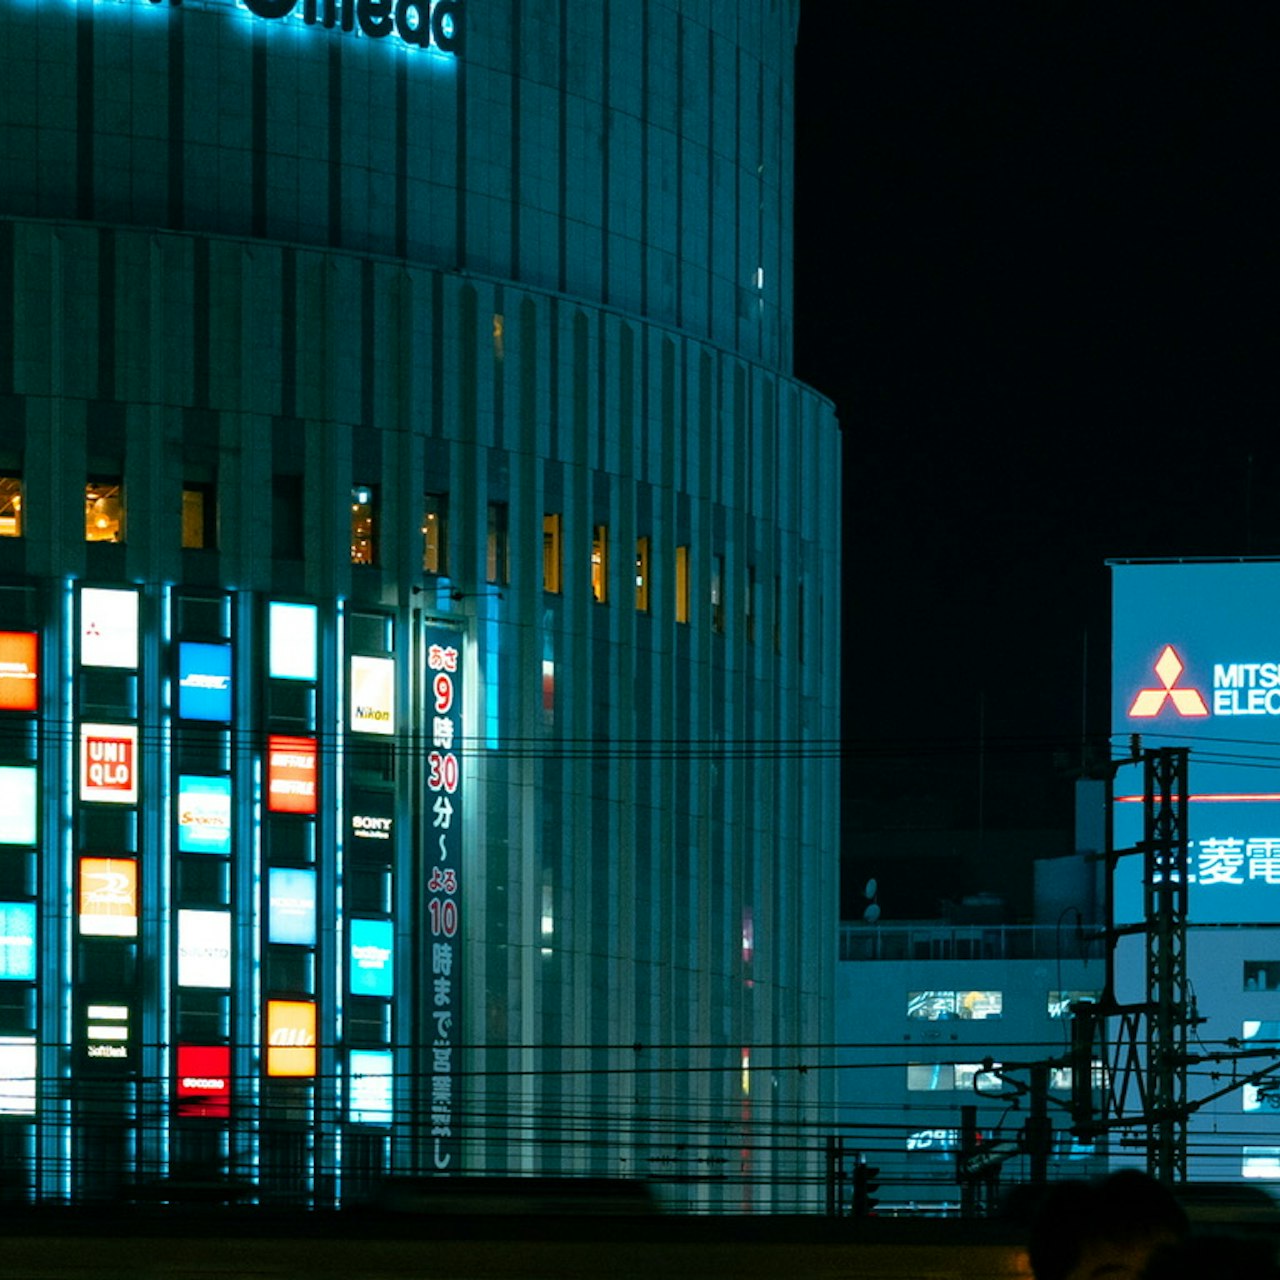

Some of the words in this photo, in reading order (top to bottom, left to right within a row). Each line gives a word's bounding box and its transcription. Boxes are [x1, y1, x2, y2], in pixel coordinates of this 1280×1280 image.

[355, 706, 390, 722] Nikon
[89, 741, 126, 761] UNI
[89, 763, 129, 786] QLO
[352, 815, 392, 830] SONY
